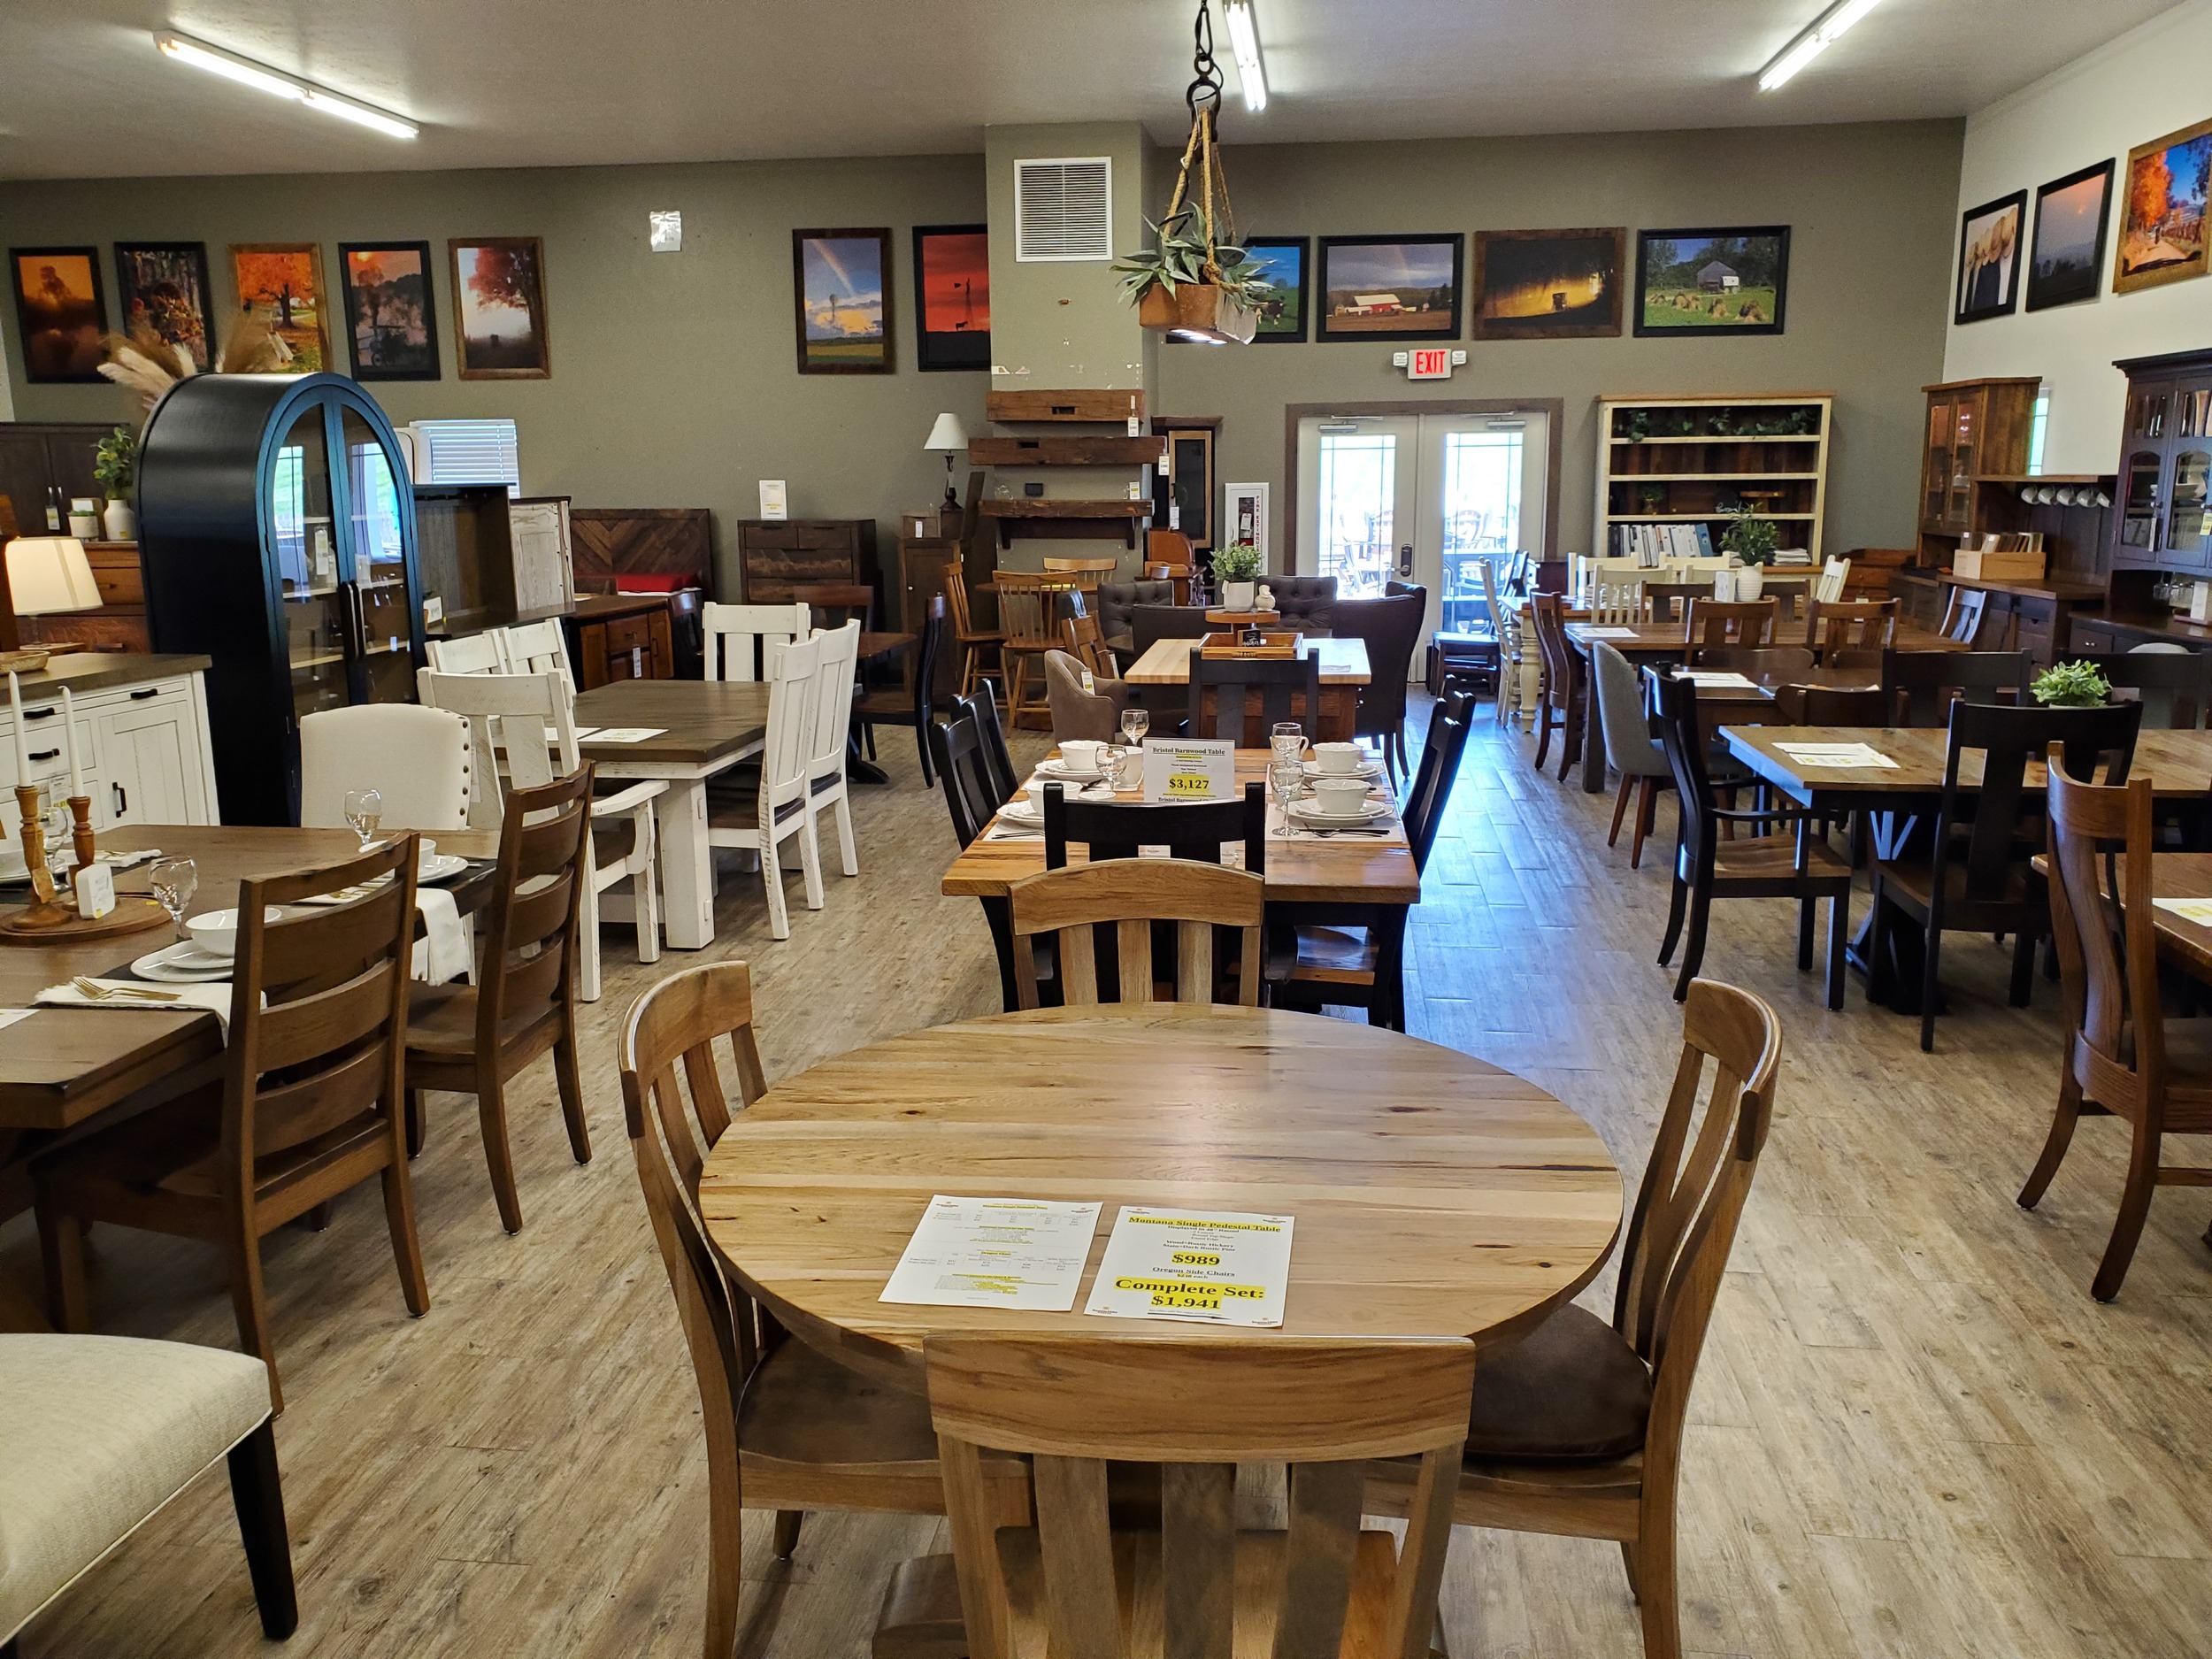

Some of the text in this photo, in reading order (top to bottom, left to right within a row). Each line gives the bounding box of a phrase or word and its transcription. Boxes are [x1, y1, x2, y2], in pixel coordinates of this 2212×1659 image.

[1416, 351, 1446, 373] EXIT
[1169, 778, 1210, 790] $3,127
[1128, 1217, 1174, 1225] Montana
[1171, 1254, 1220, 1265] $989
[1115, 1279, 1264, 1298] Complete Set:
[1151, 1294, 1220, 1310] $1,941
